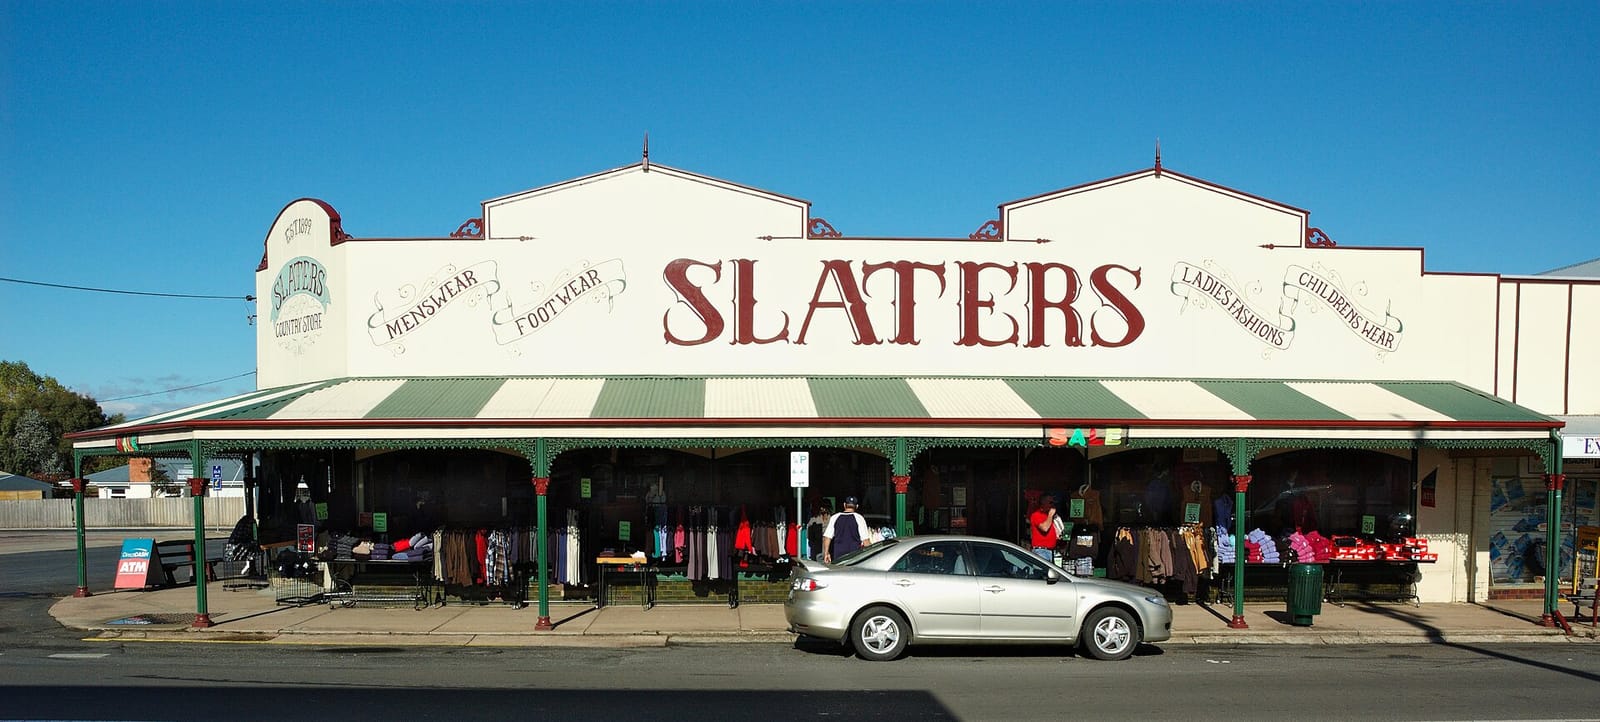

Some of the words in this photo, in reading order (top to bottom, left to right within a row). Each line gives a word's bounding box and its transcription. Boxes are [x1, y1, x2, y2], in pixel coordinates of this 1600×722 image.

[273, 260, 325, 310] SLATERS
[386, 270, 478, 339] MENSWEAR
[514, 269, 602, 335] FOOTWEAR
[663, 258, 1146, 348] SLATERS
[1181, 266, 1233, 306] LADIES
[1227, 297, 1285, 346] FASHIONS
[1298, 272, 1363, 330] CHILDRENS
[1360, 320, 1395, 349] WEAR
[275, 316, 302, 338] COUNTRY
[302, 312, 322, 333] STORE
[1049, 428, 1122, 446] SALE
[120, 561, 146, 573] ATM
